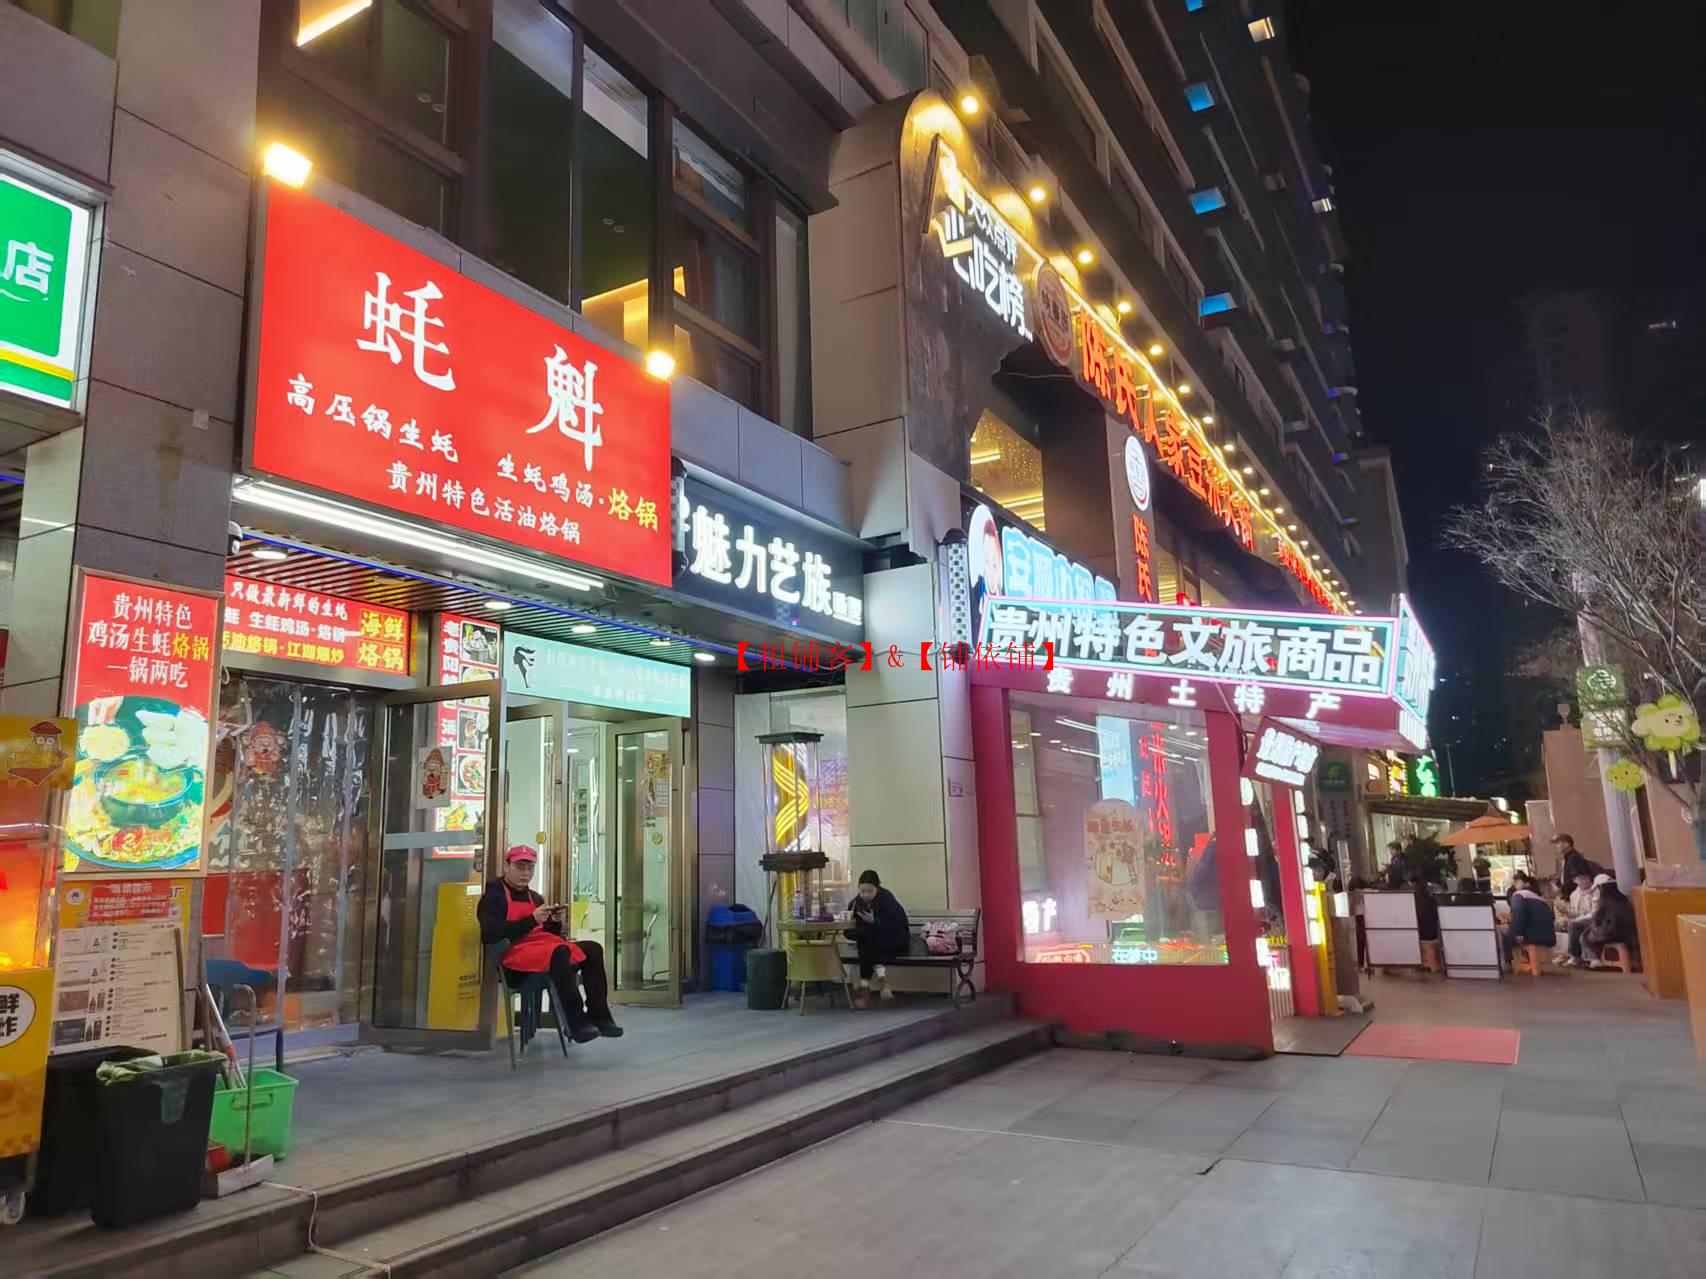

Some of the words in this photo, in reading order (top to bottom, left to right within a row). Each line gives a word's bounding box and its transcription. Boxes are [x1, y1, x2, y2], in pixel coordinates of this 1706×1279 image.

[286, 373, 459, 464] 高压锅生蚝
[386, 460, 582, 545] 贵州特色活油烙锅
[689, 504, 834, 616] 魅力艺族
[112, 592, 193, 630] 贵州特色
[230, 581, 349, 621] 只做最新鲜的生蚝
[86, 620, 210, 662] 鸡汤生蚝烙锅
[359, 611, 405, 643] 海鲜
[989, 604, 1381, 684] 贵州特色文旅商品
[106, 656, 189, 688] 一锅两吃
[357, 641, 405, 671] 烙锅
